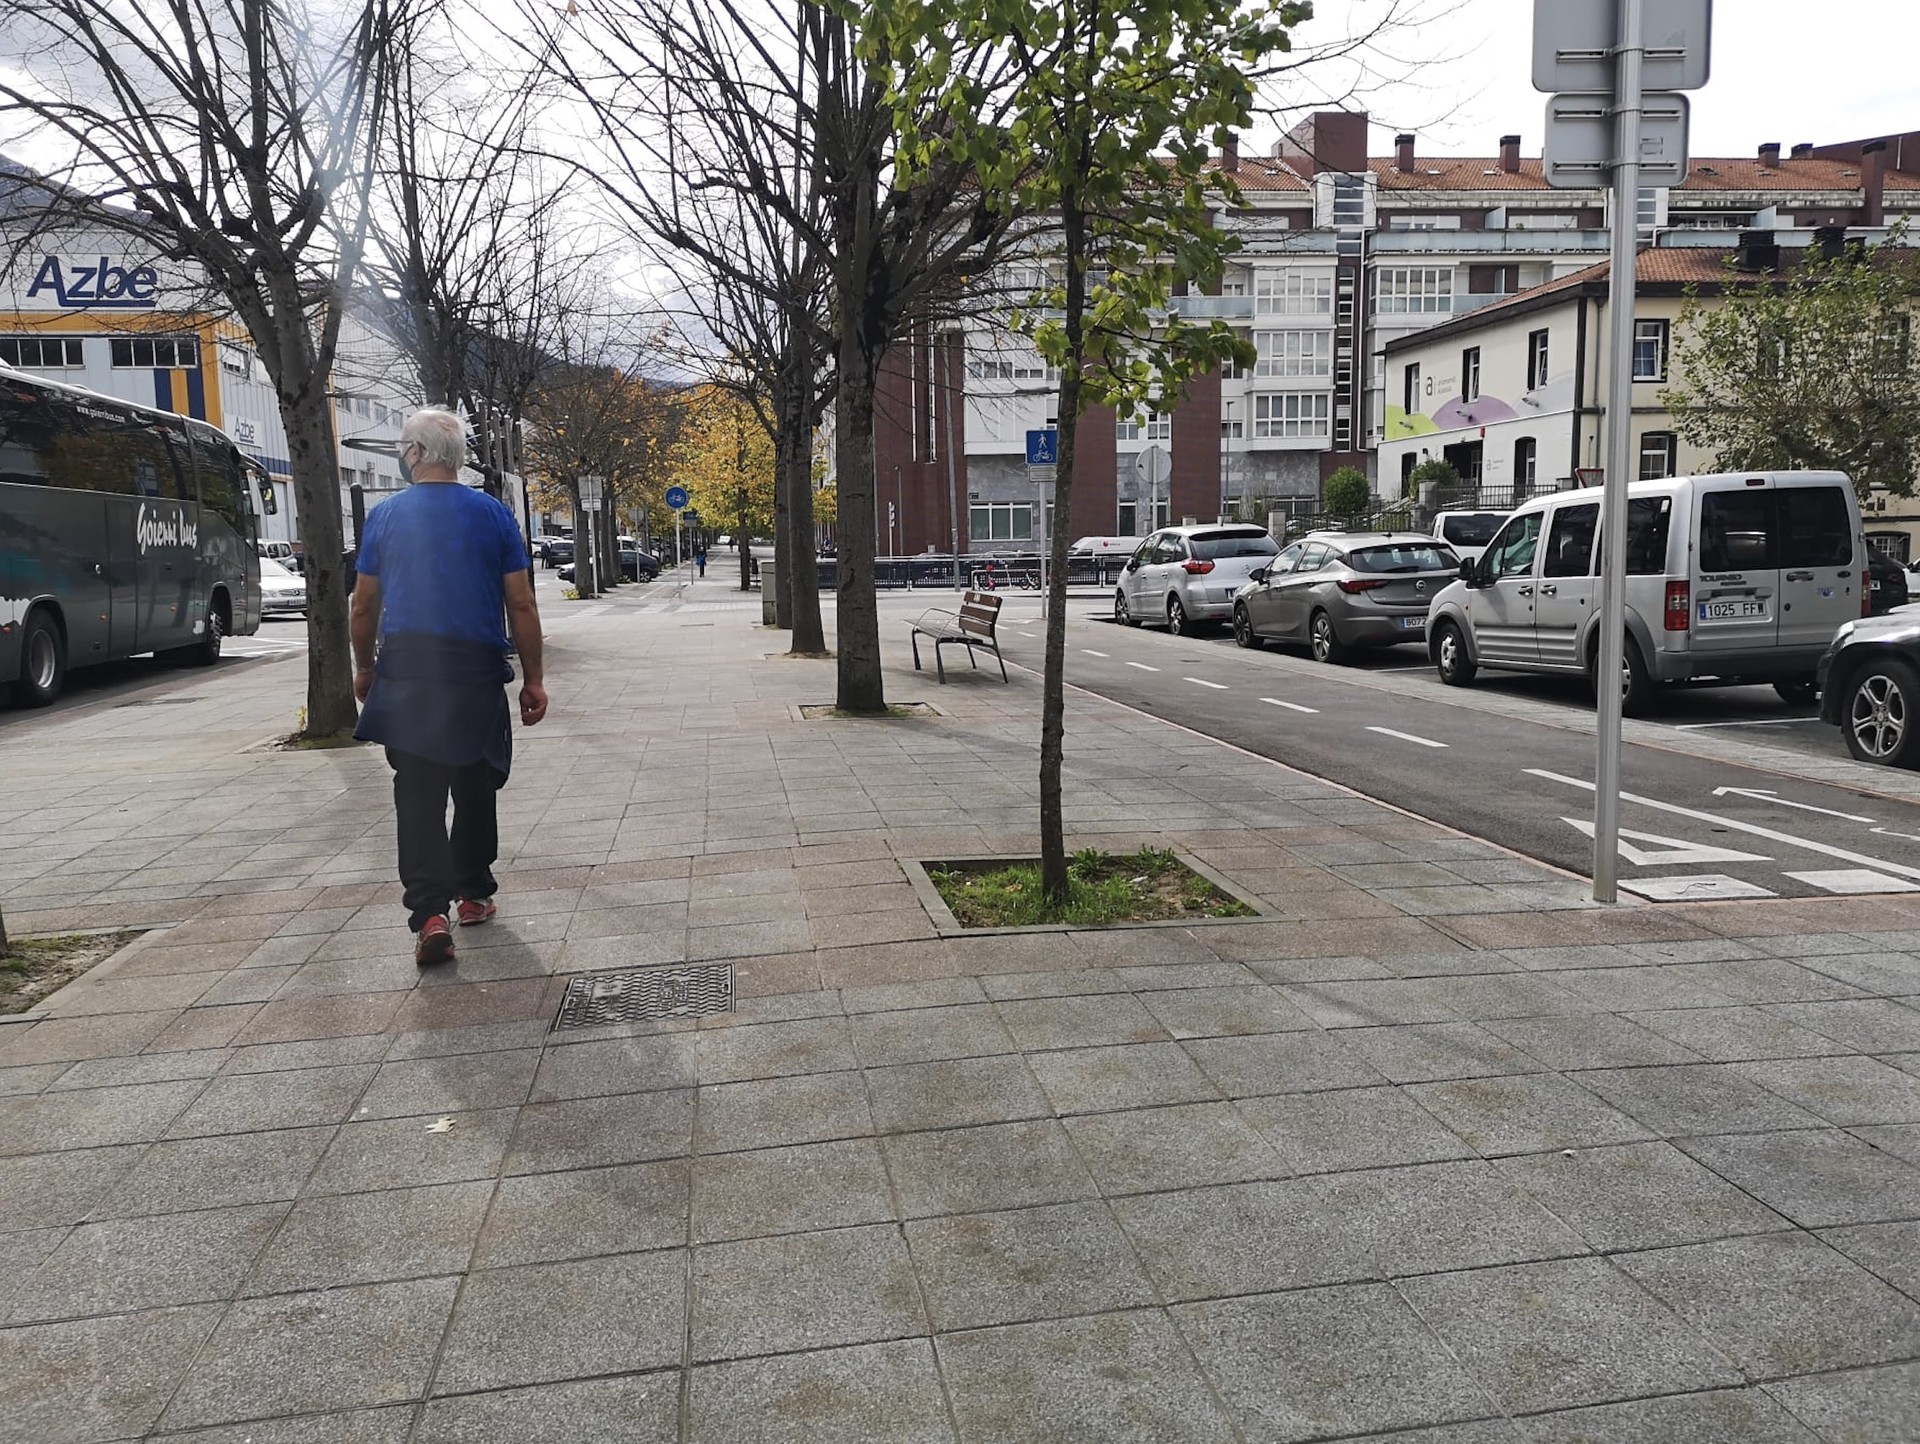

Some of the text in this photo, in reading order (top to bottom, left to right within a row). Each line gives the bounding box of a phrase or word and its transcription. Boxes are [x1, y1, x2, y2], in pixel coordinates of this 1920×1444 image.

[26, 256, 157, 306] Azbe
[234, 415, 255, 444] Azbe
[179, 507, 198, 549] bus
[1708, 602, 1765, 617] 1025 FFW
